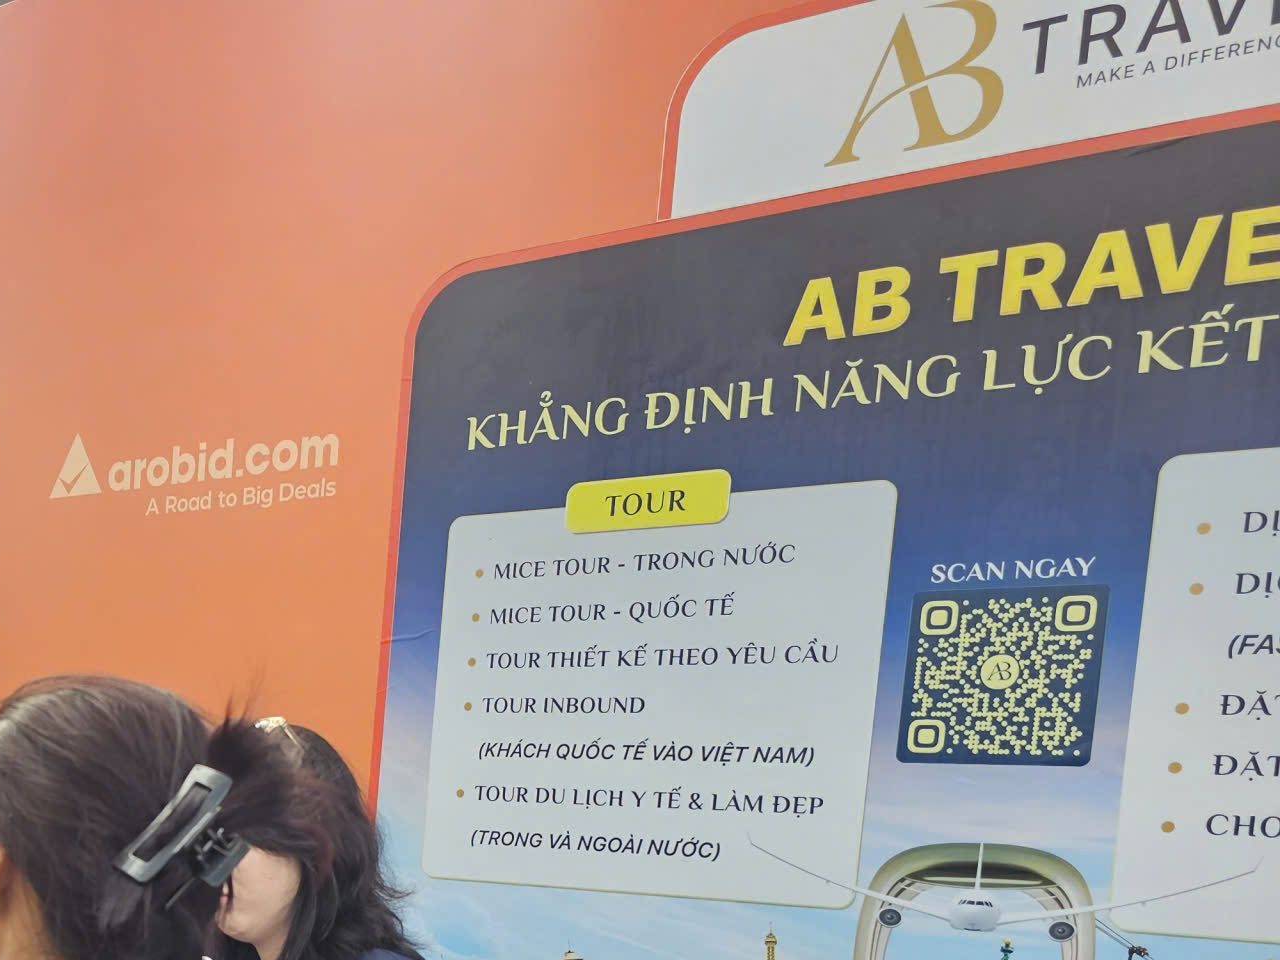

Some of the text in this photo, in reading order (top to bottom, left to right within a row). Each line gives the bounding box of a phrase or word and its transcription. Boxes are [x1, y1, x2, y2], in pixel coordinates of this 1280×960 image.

[1076, 59, 1157, 89] MAKE A
[782, 204, 1280, 347] AB TRAVE
[644, 377, 775, 434] ĐỊNH
[795, 353, 962, 413] NĂNG
[982, 333, 1113, 396] LỰC
[1137, 303, 1280, 374] KẾT
[108, 432, 340, 492] arobid.com
[145, 477, 337, 517] A Road to Big Deals
[604, 489, 688, 518] TOUR
[493, 540, 797, 581] MICE TOUR TRONG NƯỚC
[930, 556, 1096, 584] SCAN NGAY
[489, 591, 735, 626] MICE TOUR QUỐC TẾ
[486, 637, 840, 671] TOUR THIẾT KẾ THEO YÊU CẦU
[482, 695, 646, 715] TOUR INBOUND
[477, 735, 816, 768] (KHÁCH QUỐC TẾ VÀO VIỆT NAM)
[474, 783, 825, 818] TOUR DU LỊCH Y TẾ & LÀM ĐẸP
[470, 827, 722, 863] (TRONG VÀ NGOÀI NƯỚC)
